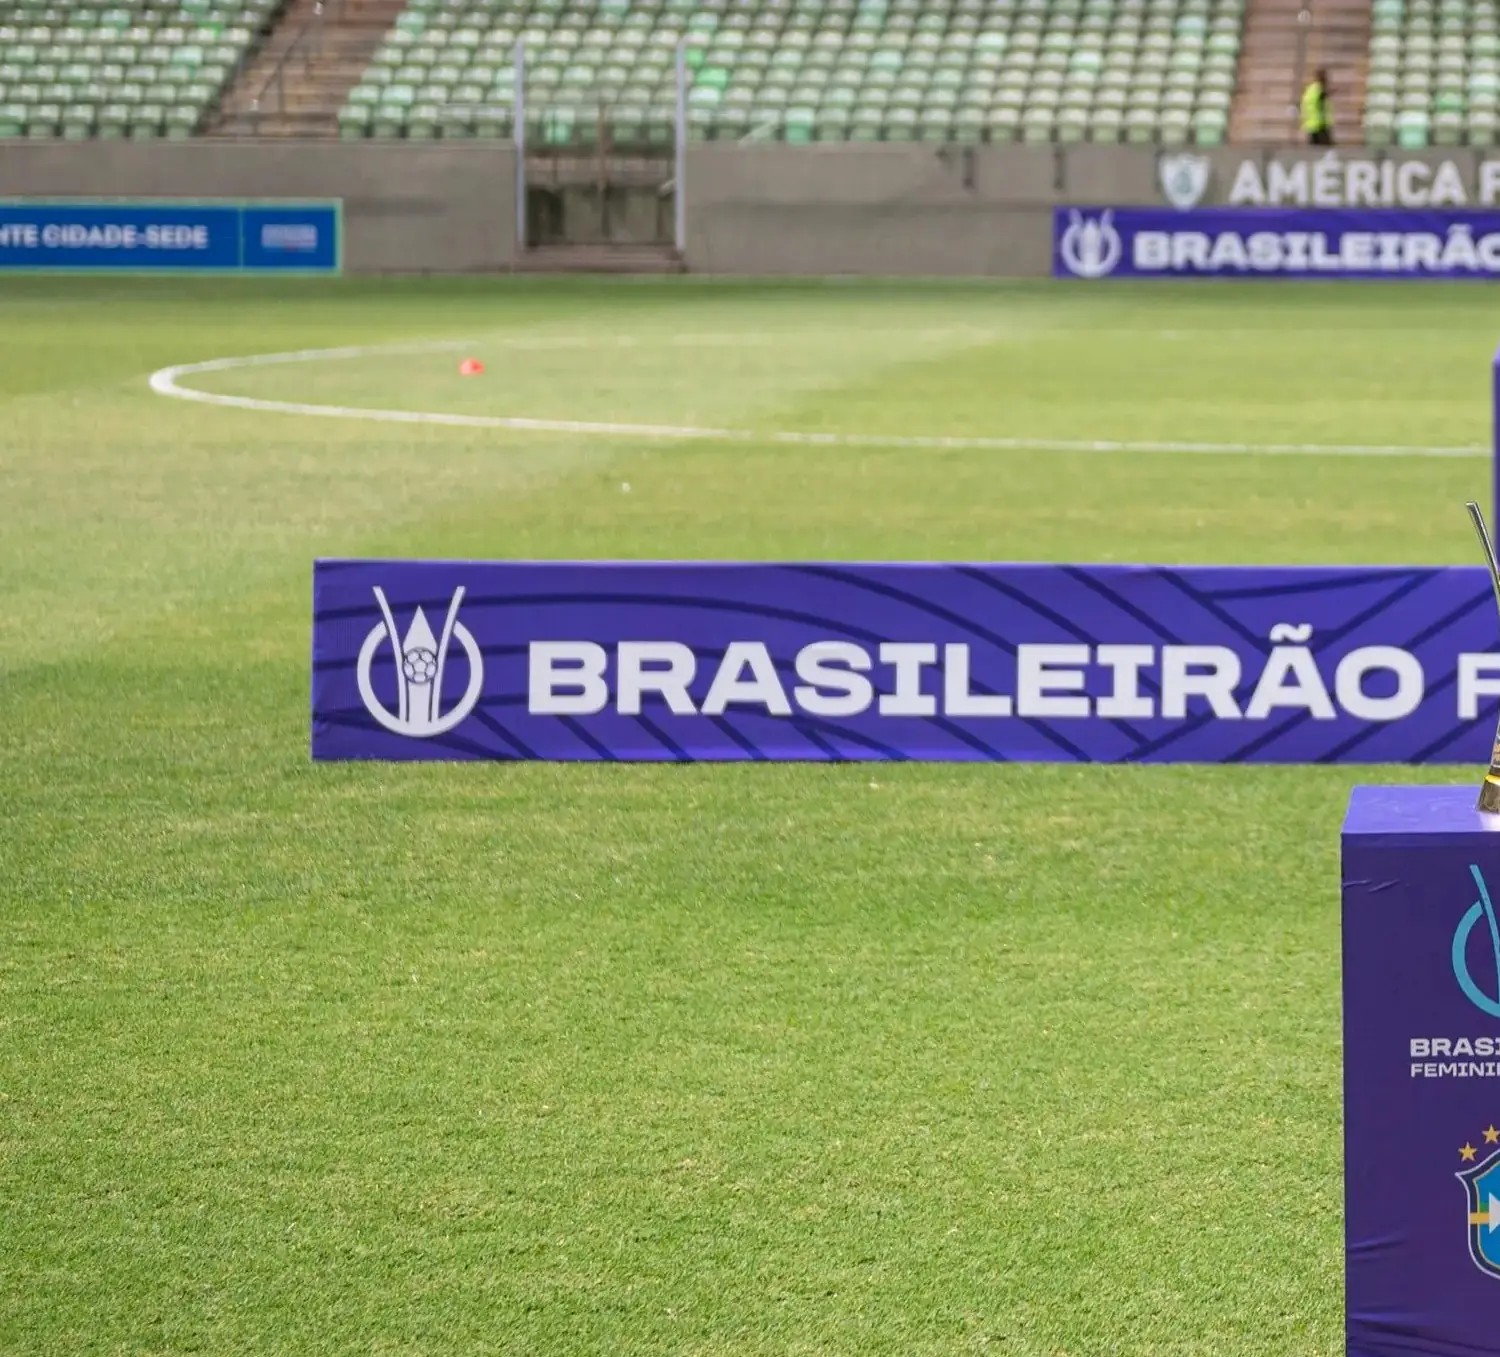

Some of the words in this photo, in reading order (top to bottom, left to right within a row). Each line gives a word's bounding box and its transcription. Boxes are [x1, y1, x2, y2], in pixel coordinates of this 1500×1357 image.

[1229, 152, 1467, 206] AMÉRICA
[42, 224, 208, 249] CIDADE-SEDE
[528, 623, 1425, 721] BRASILEIRÃO
